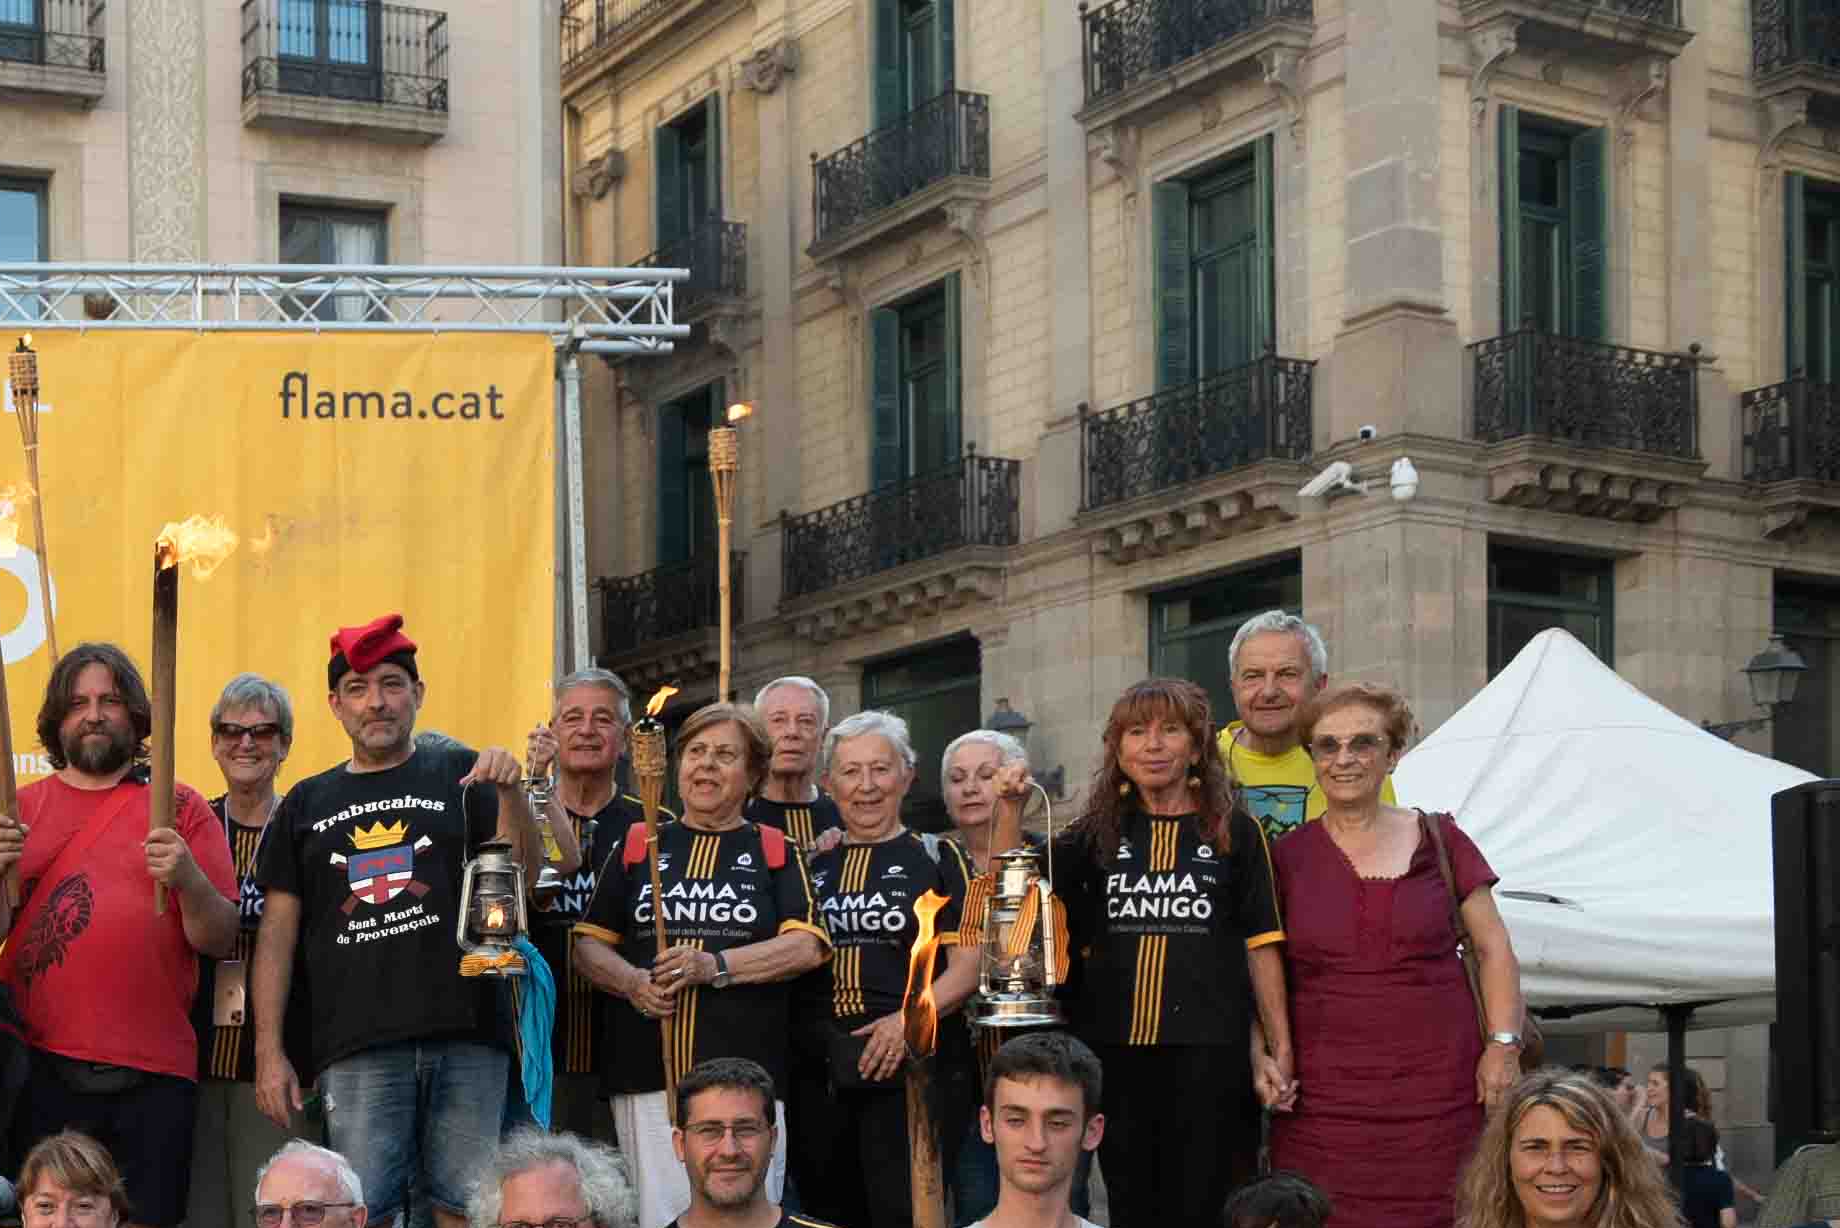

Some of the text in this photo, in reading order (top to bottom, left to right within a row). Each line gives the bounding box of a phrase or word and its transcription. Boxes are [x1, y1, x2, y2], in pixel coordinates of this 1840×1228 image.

[278, 371, 504, 420] flama.cat
[313, 794, 446, 833] Trabucaires
[1106, 872, 1198, 894] FLAMA
[634, 898, 758, 923] CANIGÓ
[820, 891, 888, 911] AMA
[1107, 893, 1212, 919] CANIGÓ
[347, 917, 377, 931] Sant
[355, 914, 440, 943] Provençals
[824, 904, 907, 932] NIGÓ
